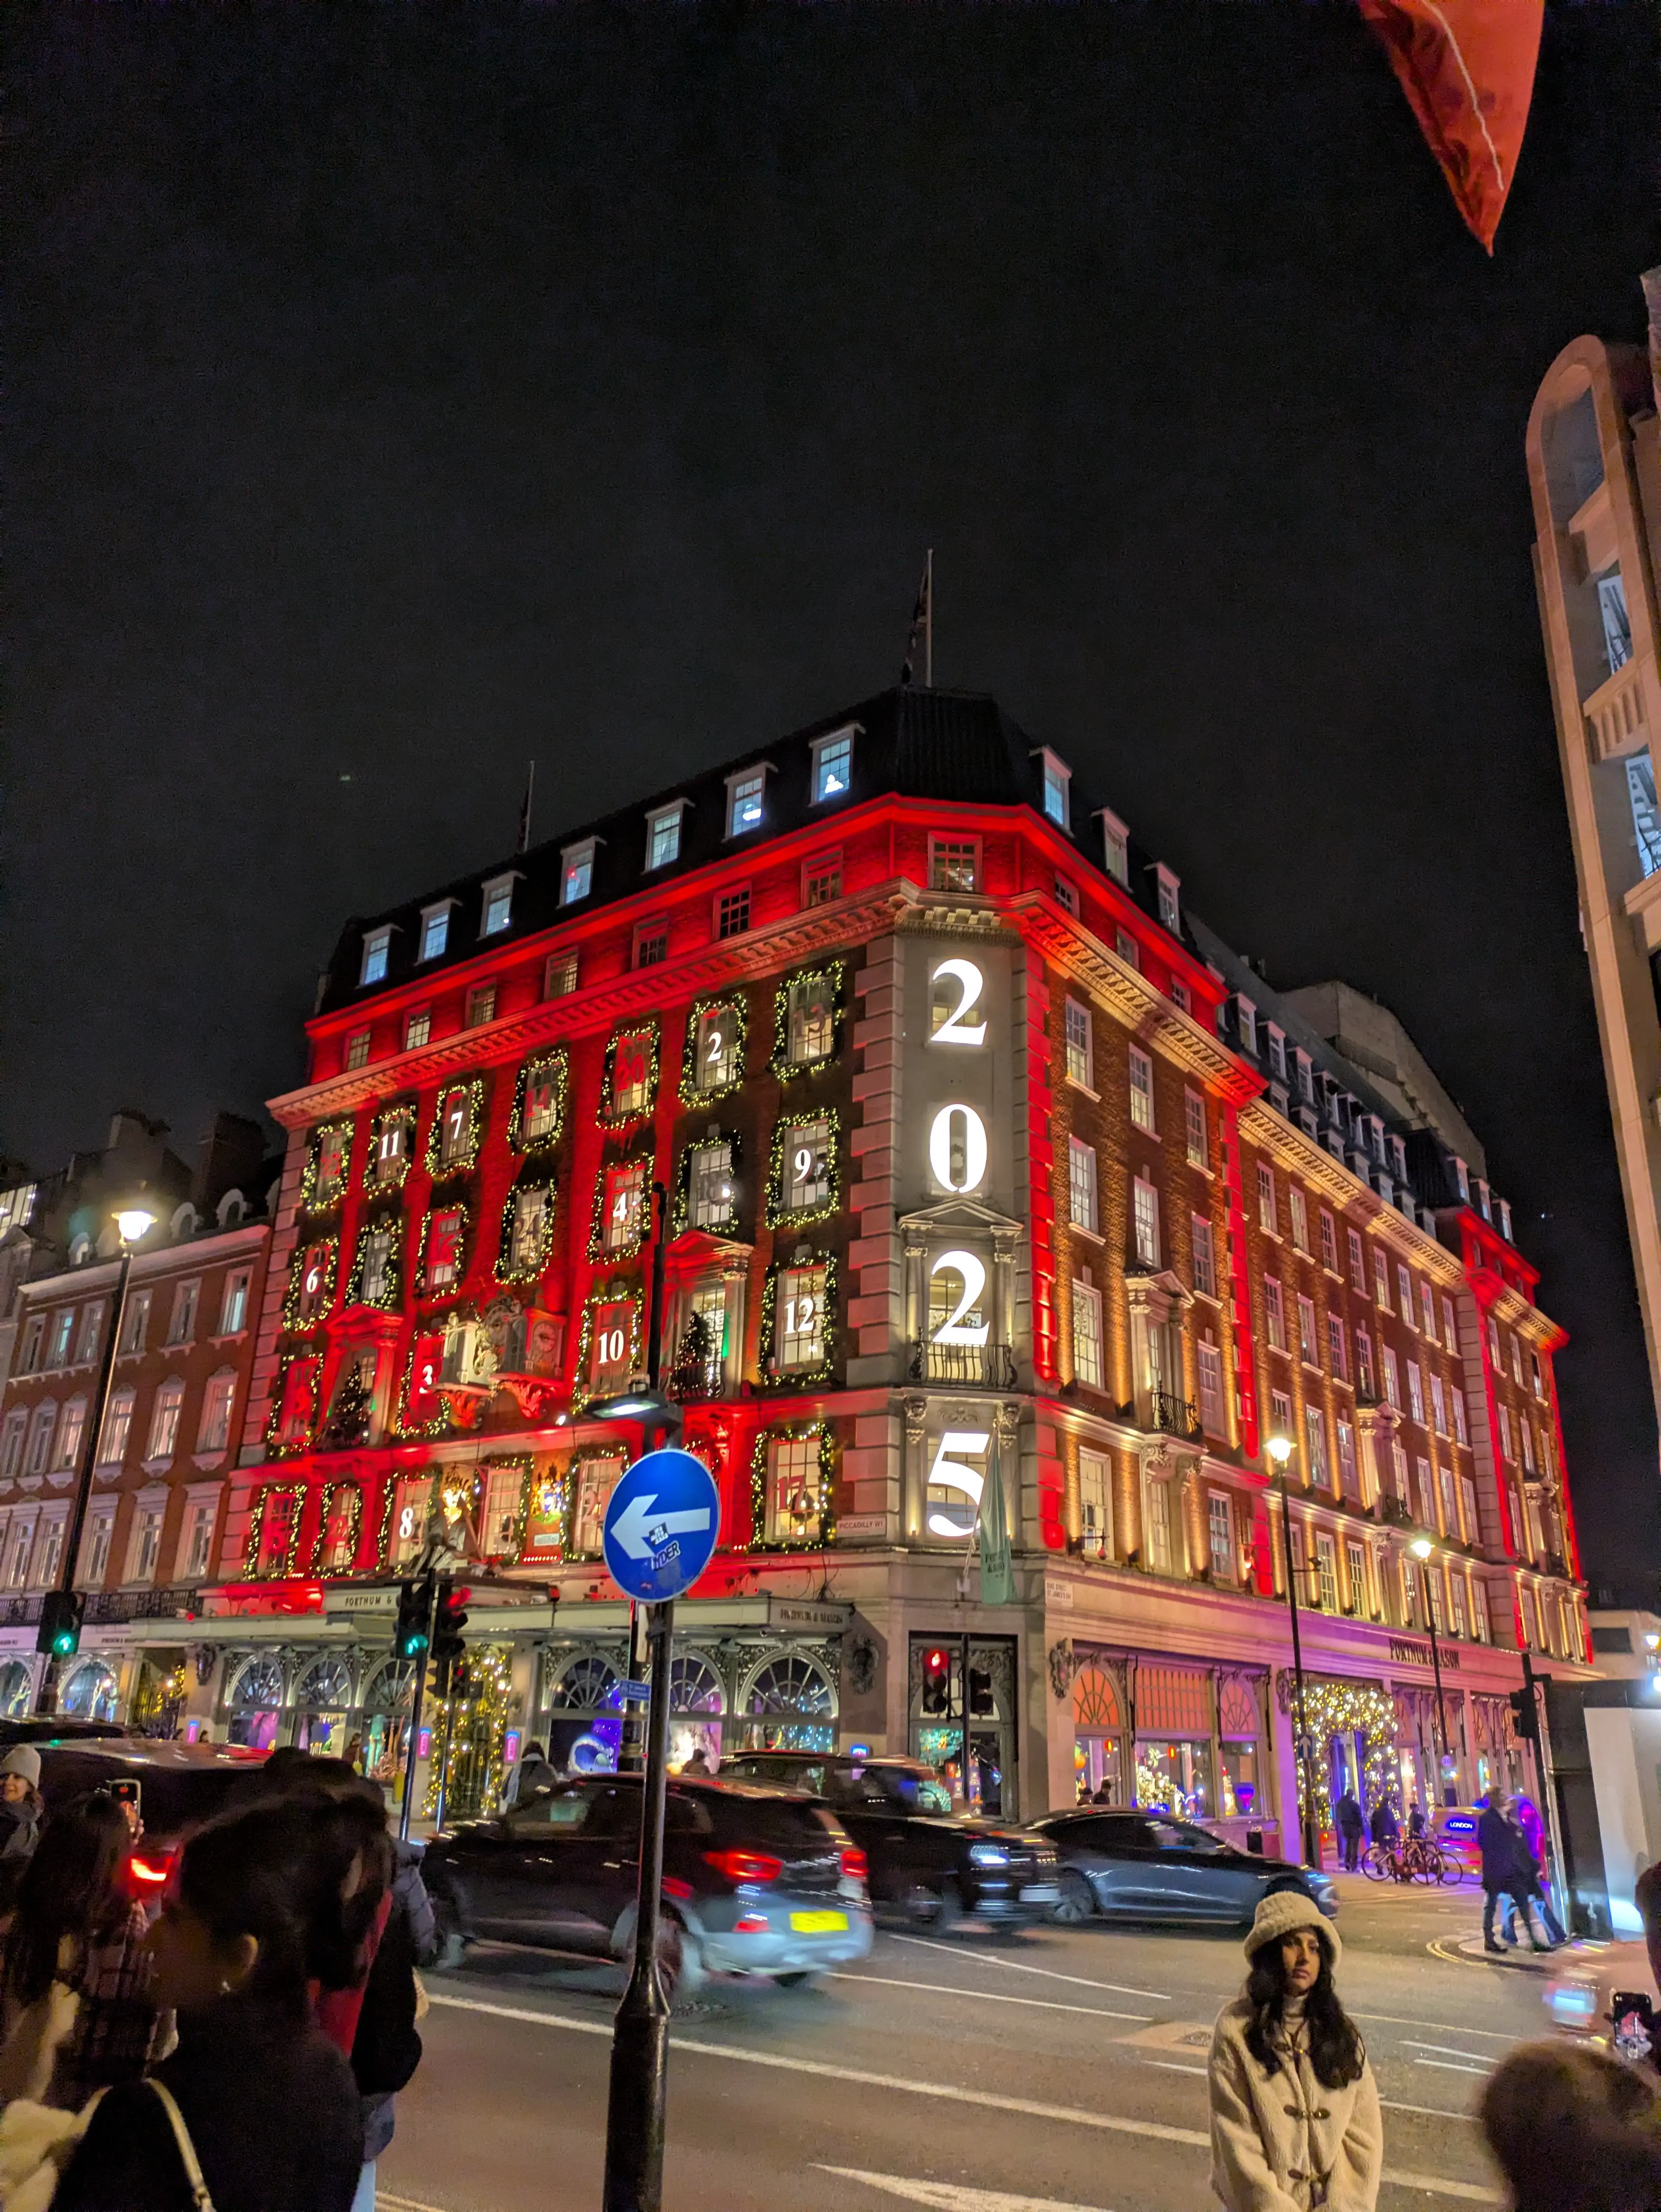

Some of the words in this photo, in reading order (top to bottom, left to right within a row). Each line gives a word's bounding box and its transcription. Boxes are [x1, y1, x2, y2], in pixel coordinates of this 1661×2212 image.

[792, 1004, 826, 1038] 13
[707, 1031, 722, 1062] 2
[616, 1057, 645, 1092] 20
[525, 1084, 550, 1117] 14
[451, 1111, 463, 1139] 7
[380, 1130, 399, 1160] 11
[794, 1149, 811, 1182] 9
[613, 1192, 627, 1221] 4
[514, 1214, 541, 1243] 24
[306, 1267, 318, 1293] 6
[784, 1297, 815, 1334] 12
[598, 1330, 624, 1363] 10
[419, 1365, 433, 1394] 3
[777, 1476, 806, 1514] 17
[399, 1507, 414, 1538] 8
[839, 1521, 873, 1529] PICCADILLY
[345, 1596, 381, 1607] FORTNUM
[1389, 1638, 1428, 1666] FORTNUM
[1437, 1648, 1460, 1669] ASON
